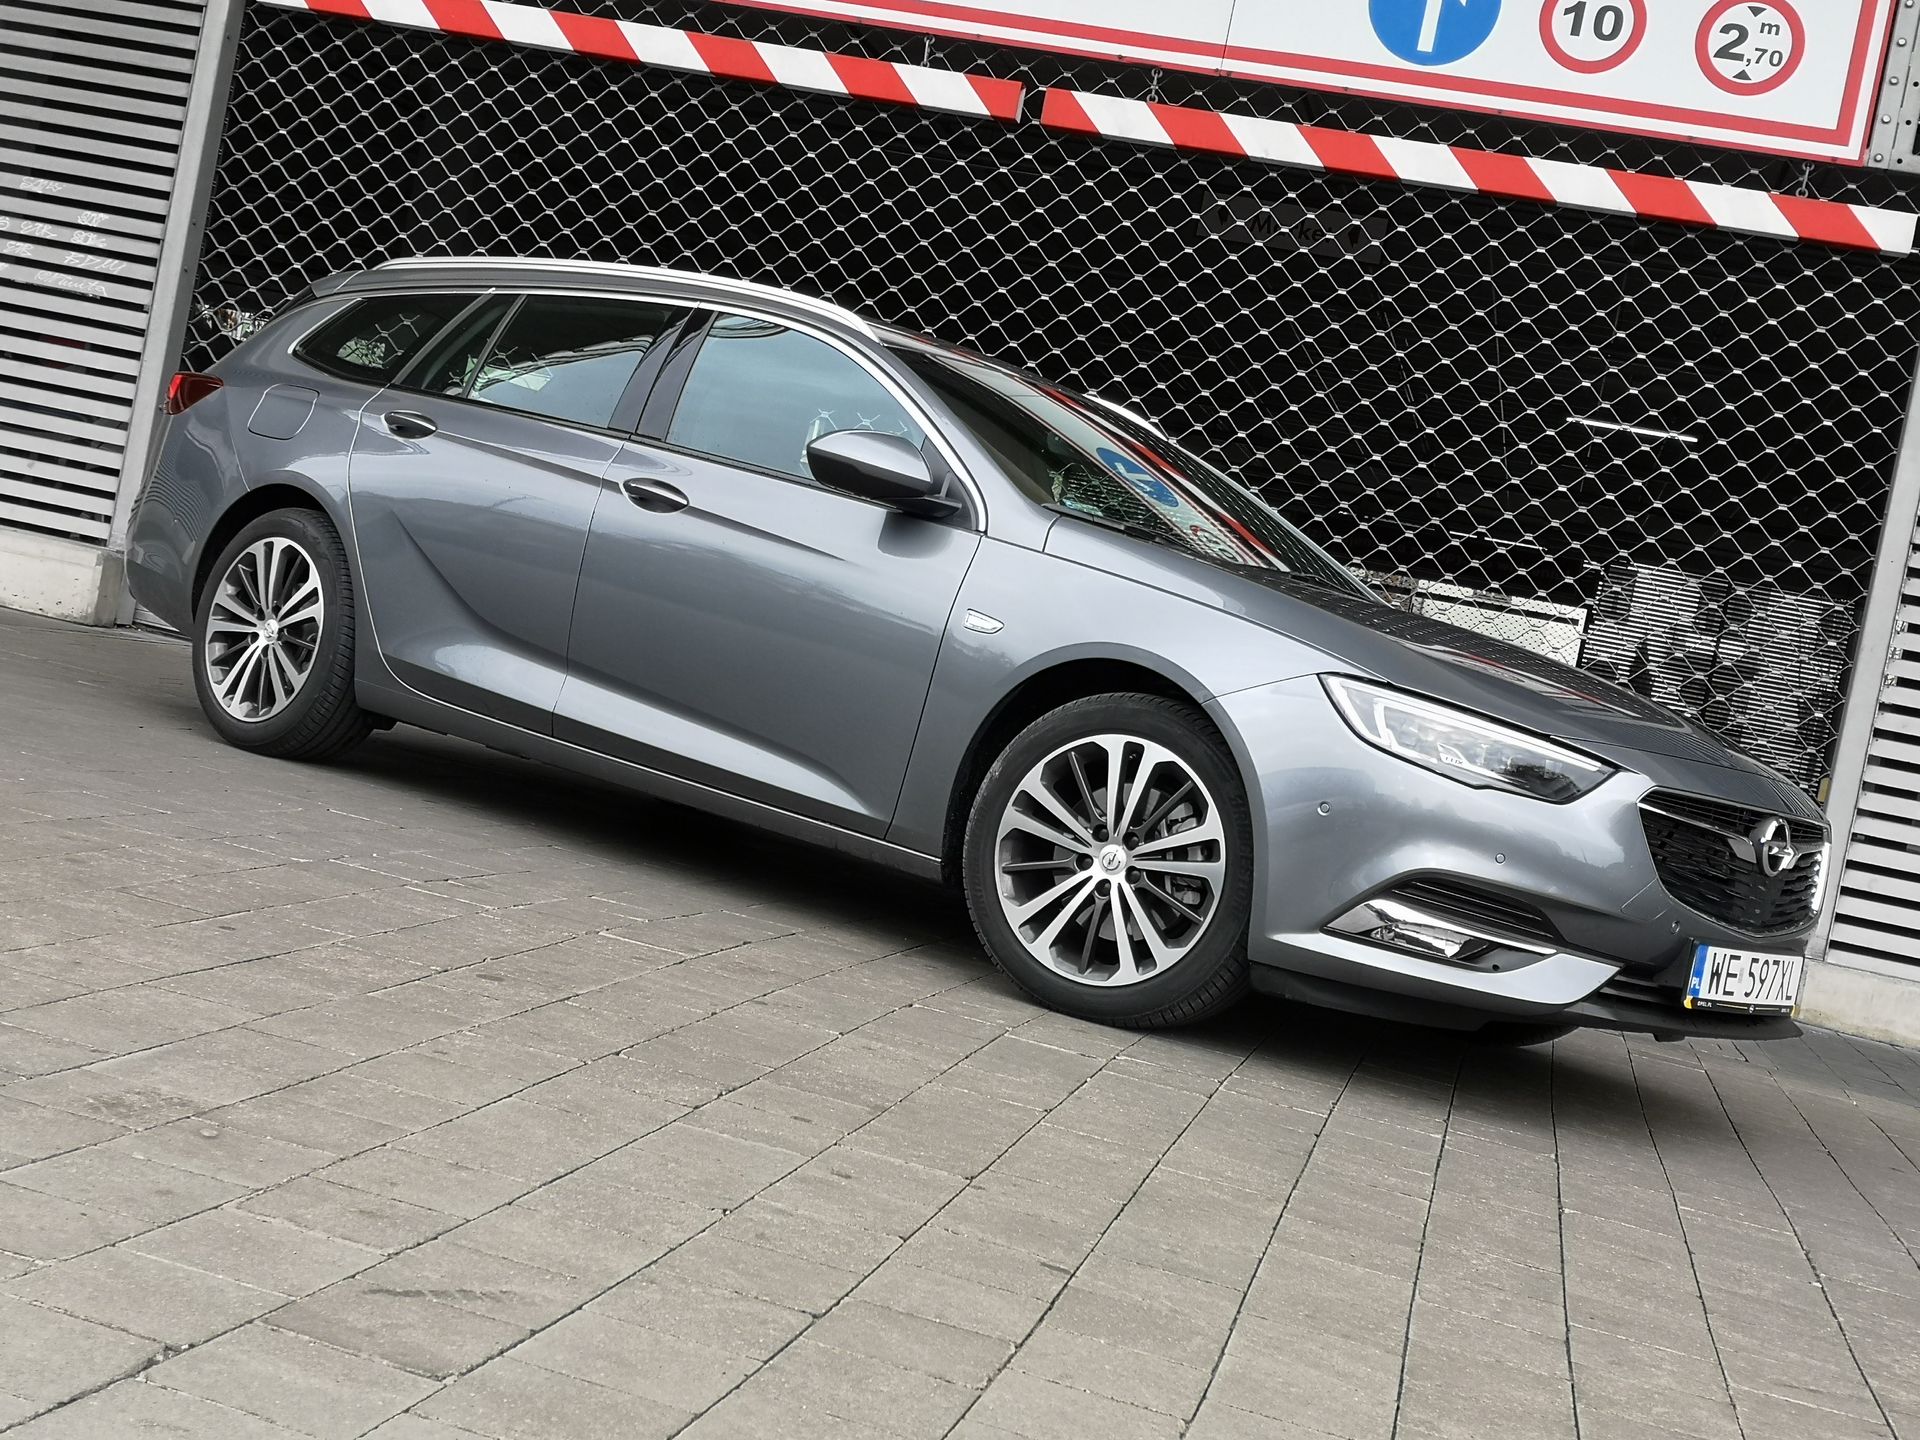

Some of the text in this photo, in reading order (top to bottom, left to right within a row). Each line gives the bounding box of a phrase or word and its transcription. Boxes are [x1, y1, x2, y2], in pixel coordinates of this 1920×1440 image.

[1563, 1, 1624, 41] 10
[1760, 22, 1780, 36] m
[1691, 976, 1700, 989] PL
[1708, 952, 1794, 1000] WE 597XL
